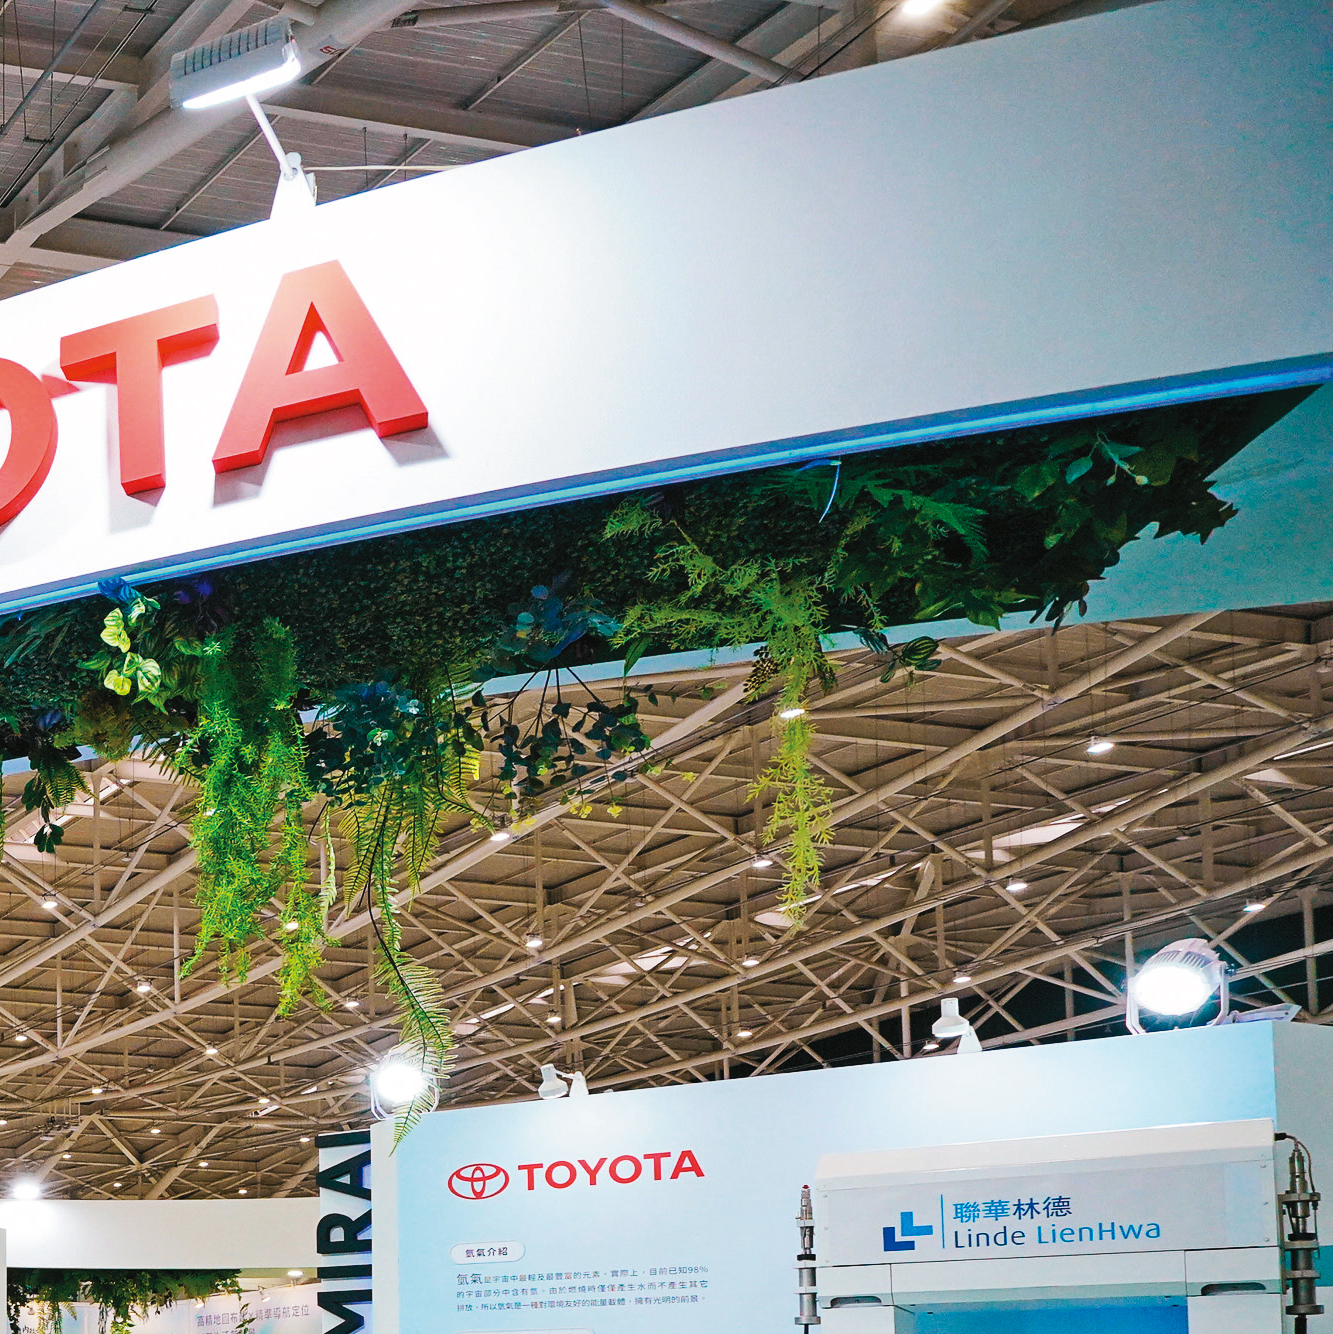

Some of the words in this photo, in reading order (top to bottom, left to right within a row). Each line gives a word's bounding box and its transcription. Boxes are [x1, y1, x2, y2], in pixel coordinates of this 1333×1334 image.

[517, 1149, 705, 1191] TOYOTA
[952, 1195, 1072, 1224] 聯華林德
[953, 1226, 1026, 1249] Linde
[1037, 1220, 1162, 1245] LienHwa
[465, 1246, 508, 1259] 氫氣介紹
